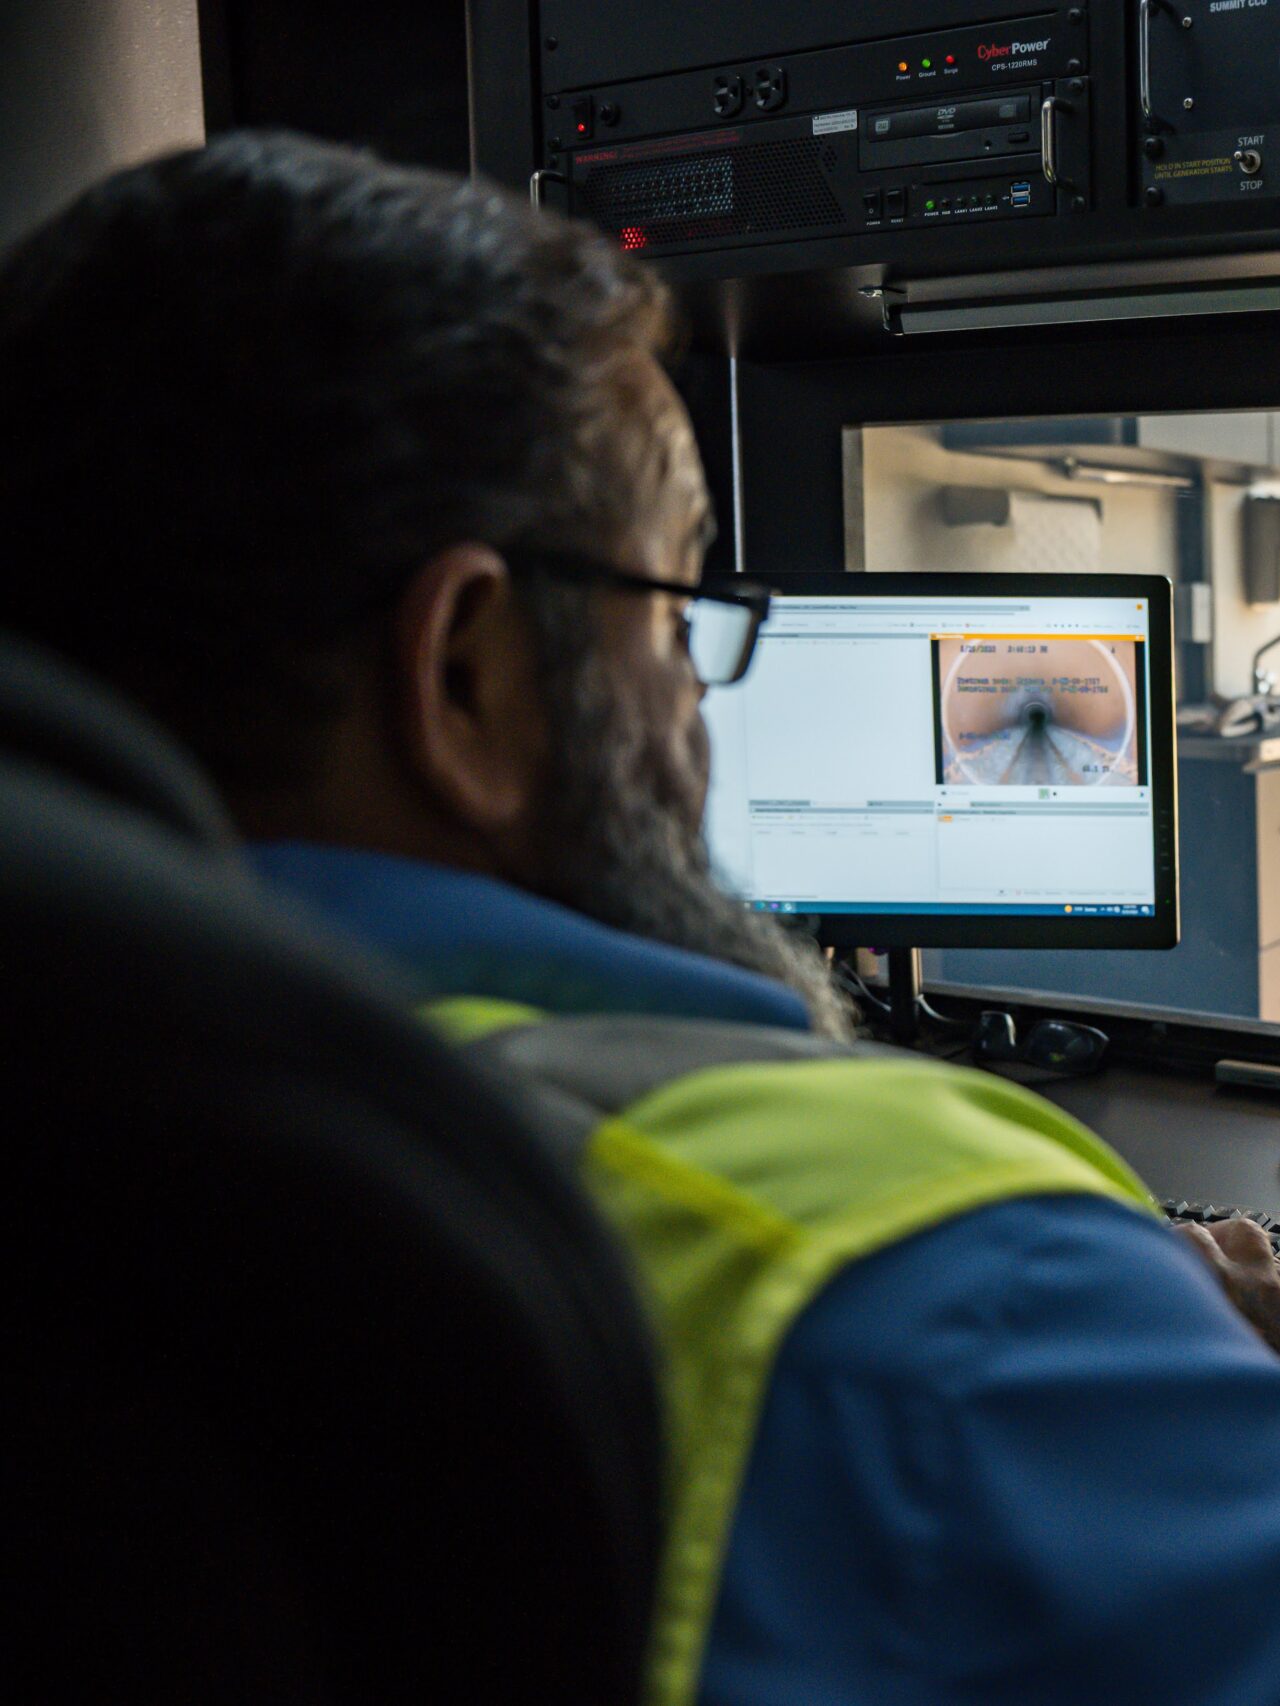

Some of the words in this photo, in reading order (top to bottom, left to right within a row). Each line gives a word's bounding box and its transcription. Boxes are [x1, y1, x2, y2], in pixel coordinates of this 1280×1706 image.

[1209, 0, 1246, 12] SUMMIT
[977, 39, 1050, 62] CyberPower
[991, 58, 1038, 72] CPS-1220RMS
[895, 73, 911, 81] Power
[918, 70, 937, 78] Ground
[943, 67, 959, 76] Surge
[1237, 135, 1265, 147] START
[1183, 160, 1201, 168] START
[1202, 158, 1232, 167] POSITION
[1173, 168, 1211, 177] GENERATOR
[1240, 179, 1263, 191] STOP
